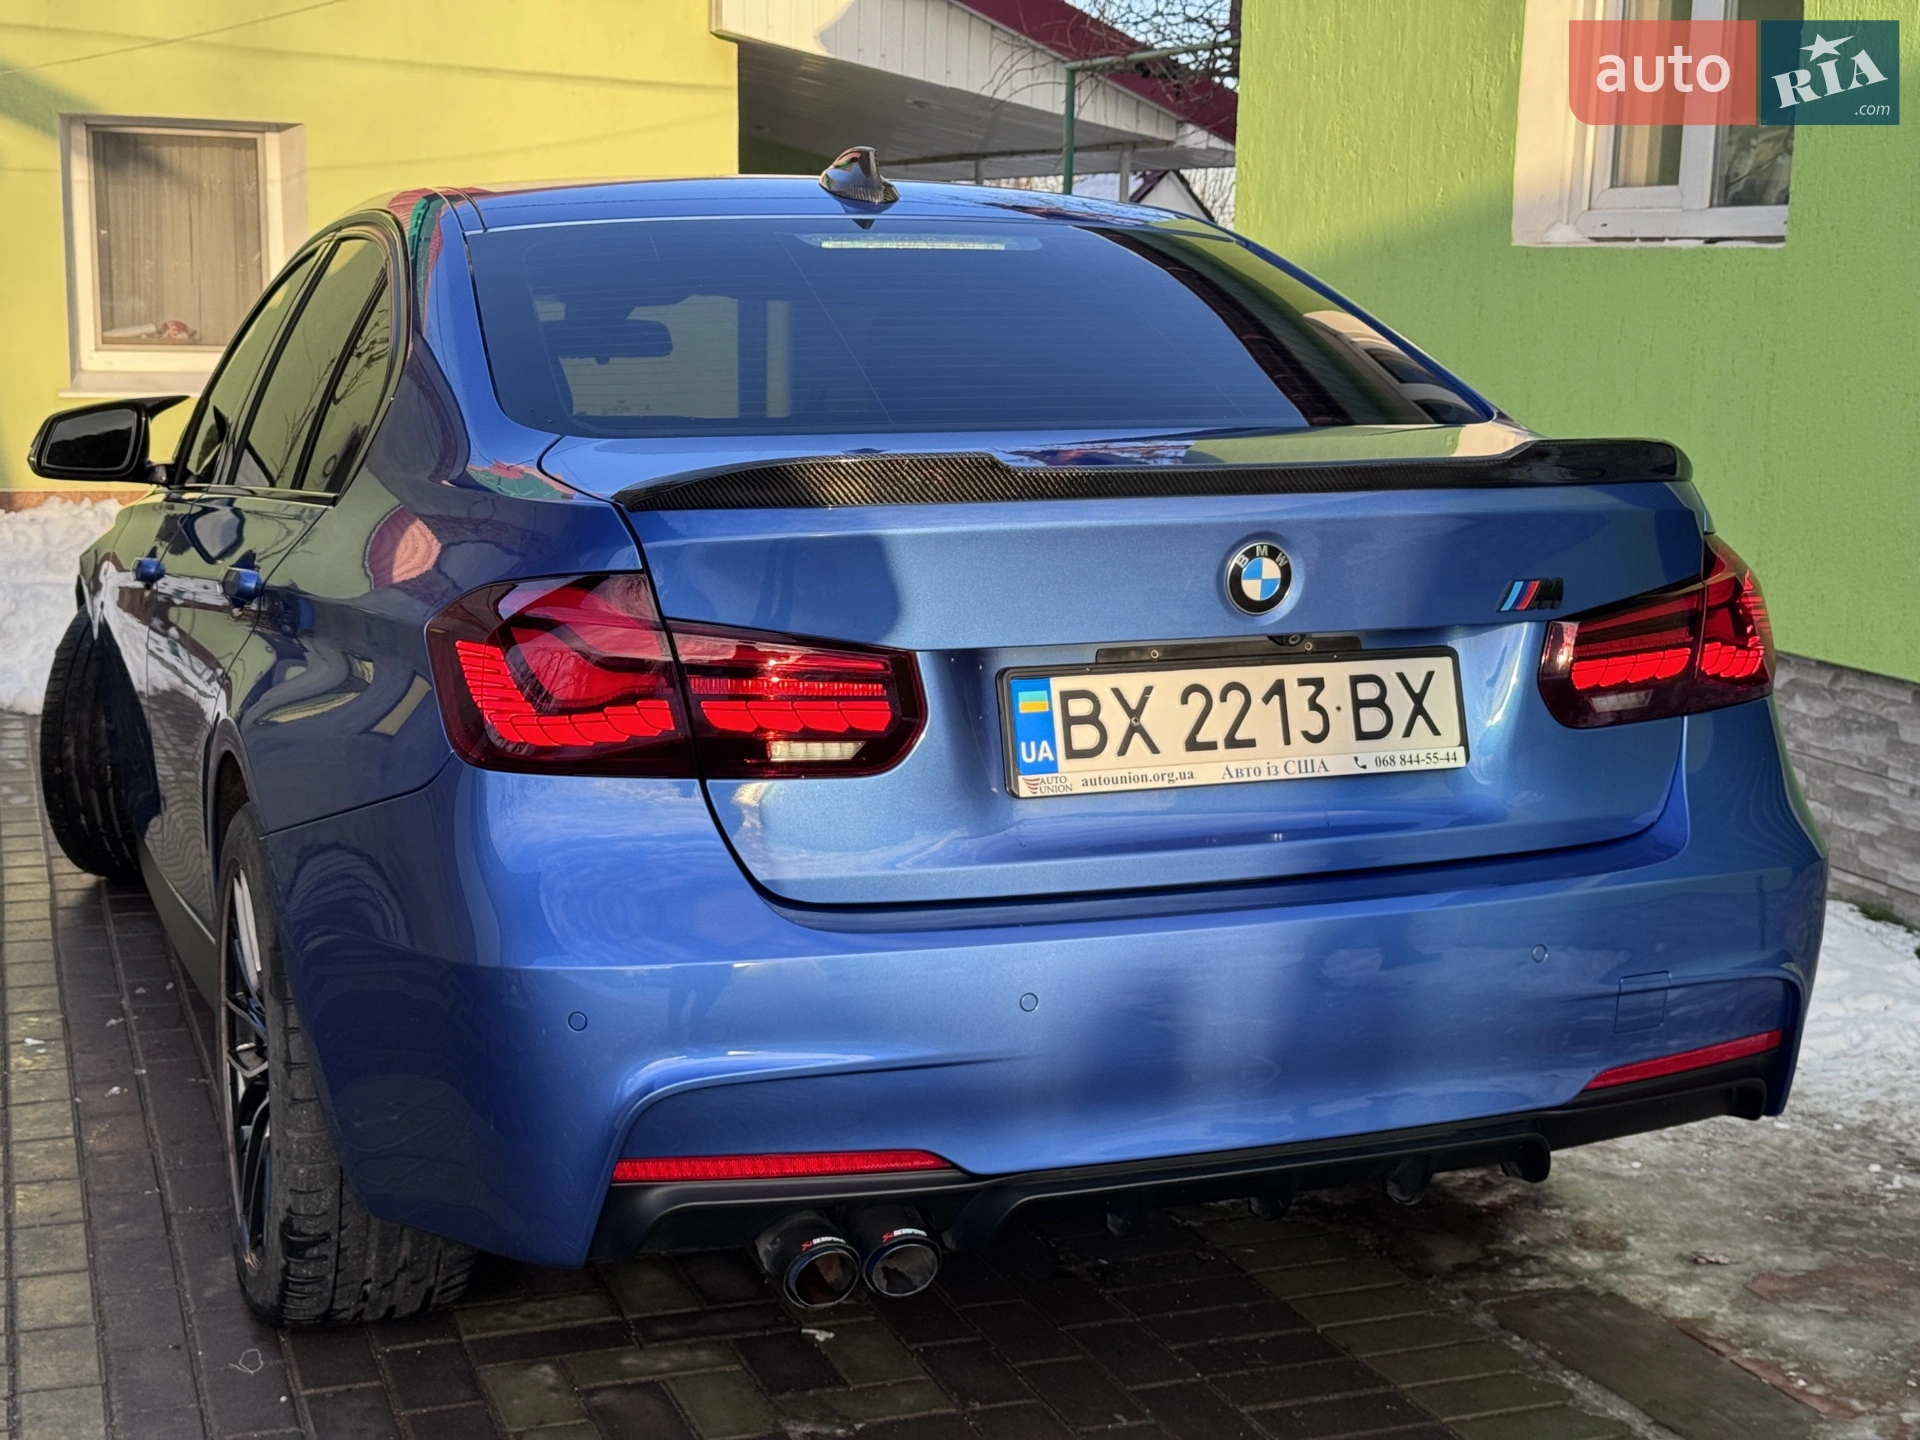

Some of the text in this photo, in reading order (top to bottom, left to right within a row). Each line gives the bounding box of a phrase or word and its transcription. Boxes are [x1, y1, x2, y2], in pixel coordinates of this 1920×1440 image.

[1235, 544, 1290, 569] BMW
[1059, 670, 1441, 760] BX 2213 BX
[1020, 740, 1056, 764] UA
[1373, 750, 1459, 769] 068 844-55-44
[1081, 770, 1195, 787] autounion.org.ua
[1221, 758, 1330, 781] Авто із США
[1039, 775, 1068, 786] AUTO
[1039, 784, 1073, 794] UNION
